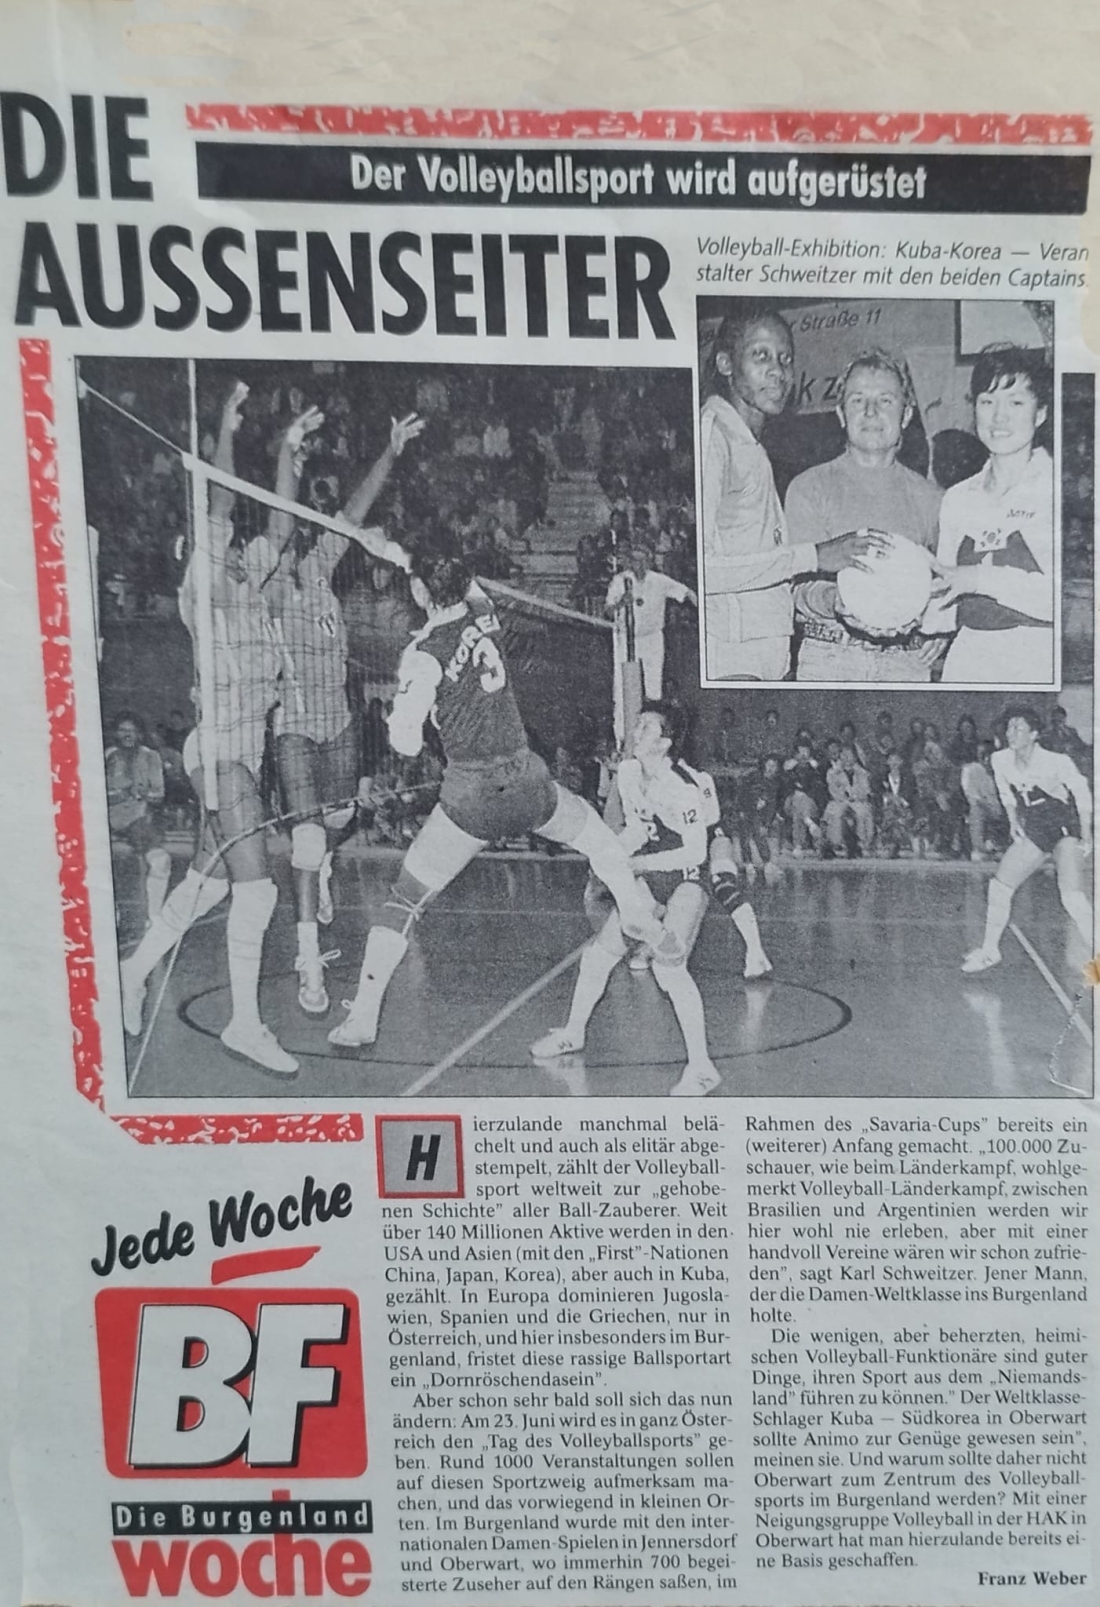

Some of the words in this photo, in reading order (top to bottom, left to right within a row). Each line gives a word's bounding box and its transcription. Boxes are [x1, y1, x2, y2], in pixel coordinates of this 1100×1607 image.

[0, 92, 151, 199] DIE
[351, 153, 407, 190] Der
[417, 155, 655, 204] Volleyballsport
[666, 157, 736, 196] wird
[748, 158, 927, 207] aufgerüstet
[697, 236, 886, 261] Volleyball-Exhibition:
[895, 240, 1001, 260] Kuba-Korea
[16, 222, 675, 338] AUSSENSEITER
[696, 263, 753, 282] stalter
[760, 264, 857, 284] Schweitzer
[863, 267, 893, 284] mit
[900, 266, 933, 285] den
[940, 267, 1001, 286] beiden
[1008, 268, 1089, 291] Captains.
[800, 309, 859, 332] Straße
[866, 308, 881, 325] 11
[445, 613, 501, 682] KORE
[473, 637, 506, 693] 3
[682, 808, 699, 825] 12
[474, 1116, 562, 1132] ierzulande
[580, 1116, 667, 1132] manchmal
[684, 1116, 725, 1132] belä-
[405, 1135, 441, 1181] H
[746, 1138, 827, 1158] (weiterer)
[832, 1138, 893, 1158] Anfang
[898, 1138, 972, 1158] gemacht.
[1057, 1138, 1087, 1154] Zu-
[477, 1182, 521, 1201] sport
[530, 1181, 603, 1196] weltweit
[613, 1185, 641, 1196] zur
[747, 1180, 796, 1196] merkt
[800, 1180, 1008, 1200] Volleyball-Länderkampf,
[1012, 1181, 1087, 1196] zwischen
[91, 1211, 194, 1277] Jede
[209, 1176, 353, 1248] Woche
[383, 1224, 421, 1240] über
[427, 1224, 456, 1239] 140
[461, 1224, 543, 1239] Millionen
[549, 1223, 604, 1239] Aktive
[609, 1223, 671, 1239] werden
[676, 1223, 692, 1238] in
[697, 1223, 728, 1238] den
[748, 1223, 781, 1238] hier
[792, 1223, 833, 1238] wohl
[845, 1223, 871, 1238] nie
[882, 1223, 948, 1241] erleben,
[960, 1223, 997, 1238] aber
[1008, 1223, 1035, 1238] mit
[1046, 1223, 1088, 1238] einer
[385, 1267, 440, 1285] China,
[445, 1267, 498, 1287] Japan,
[505, 1266, 565, 1286] Korea),
[572, 1266, 608, 1281] aber
[614, 1266, 653, 1281] auch
[659, 1265, 675, 1281] in
[681, 1265, 729, 1283] Kuba,
[800, 1266, 835, 1285] sagt
[839, 1265, 875, 1280] Karl
[883, 1265, 977, 1280] Schweitzer.
[984, 1265, 1028, 1283] Jener
[1034, 1265, 1087, 1283] Mann,
[387, 1309, 432, 1327] wien,
[440, 1309, 508, 1329] Spanien
[517, 1308, 548, 1324] und
[556, 1308, 581, 1323] die
[589, 1308, 670, 1326] Griechen,
[678, 1312, 708, 1323] nur
[714, 1307, 730, 1322] in
[750, 1307, 796, 1322] holte.
[771, 1327, 800, 1342] Die
[810, 1327, 884, 1347] wenigen,
[894, 1327, 930, 1342] aber
[939, 1327, 1025, 1345] beherzten,
[1036, 1327, 1087, 1342] heimi-
[390, 1351, 461, 1371] genland,
[468, 1350, 516, 1366] fristet
[522, 1350, 564, 1366] diese
[571, 1350, 626, 1370] rassige
[633, 1349, 731, 1369] Ballsportart
[127, 1303, 347, 1467] BF
[752, 1369, 806, 1389] Dinge,
[812, 1369, 856, 1384] ihren
[862, 1369, 908, 1389] Sport
[914, 1373, 942, 1384] aus
[948, 1368, 983, 1384] dem
[413, 1392, 453, 1408] Aber
[459, 1392, 508, 1407] schon
[514, 1392, 549, 1407] sehr
[553, 1391, 589, 1407] bald
[595, 1391, 623, 1407] soll
[629, 1391, 661, 1407] sich
[667, 1391, 695, 1406] das
[701, 1395, 732, 1406] nun
[800, 1390, 854, 1405] führen
[859, 1394, 877, 1405] zu
[961, 1389, 991, 1404] Der
[995, 1388, 1085, 1404] Weltklasse-
[394, 1434, 436, 1449] reich
[443, 1433, 474, 1449] den
[524, 1433, 552, 1448] des
[709, 1436, 733, 1451] ge-
[397, 1475, 424, 1490] auf
[431, 1474, 483, 1490] diesen
[493, 1474, 586, 1494] Sportzweig
[594, 1473, 695, 1488] aufmerksam
[704, 1477, 733, 1488] ma-
[754, 1472, 833, 1487] Oberwart
[841, 1476, 875, 1487] zum
[883, 1470, 956, 1486] Zentrum
[964, 1470, 991, 1485] des
[999, 1469, 1085, 1489] Volleyball-
[117, 1505, 165, 1528] Die
[182, 1504, 368, 1531] Burgenland
[398, 1517, 431, 1531] ten.
[435, 1515, 458, 1530] Im
[463, 1514, 560, 1534] Burgenland
[565, 1514, 618, 1529] wurde
[622, 1513, 650, 1529] mit
[655, 1513, 686, 1529] den
[691, 1513, 734, 1528] inter-
[756, 1512, 889, 1532] Neigungsgruppe
[893, 1511, 973, 1531] Volleyball
[978, 1510, 992, 1526] in
[996, 1510, 1023, 1526] der
[1027, 1510, 1067, 1525] HAK
[1072, 1510, 1086, 1525] in
[112, 1491, 371, 1597] woche
[401, 1556, 433, 1572] und
[440, 1555, 524, 1573] Oberwart,
[532, 1559, 556, 1570] wo
[564, 1554, 644, 1570] immerhin
[651, 1554, 680, 1569] 700
[687, 1553, 735, 1573] begei-
[757, 1557, 776, 1568] ne
[782, 1552, 823, 1568] Basis
[828, 1551, 918, 1571] geschaffen.
[978, 1570, 1026, 1586] Franz
[1033, 1570, 1087, 1586] Weber
